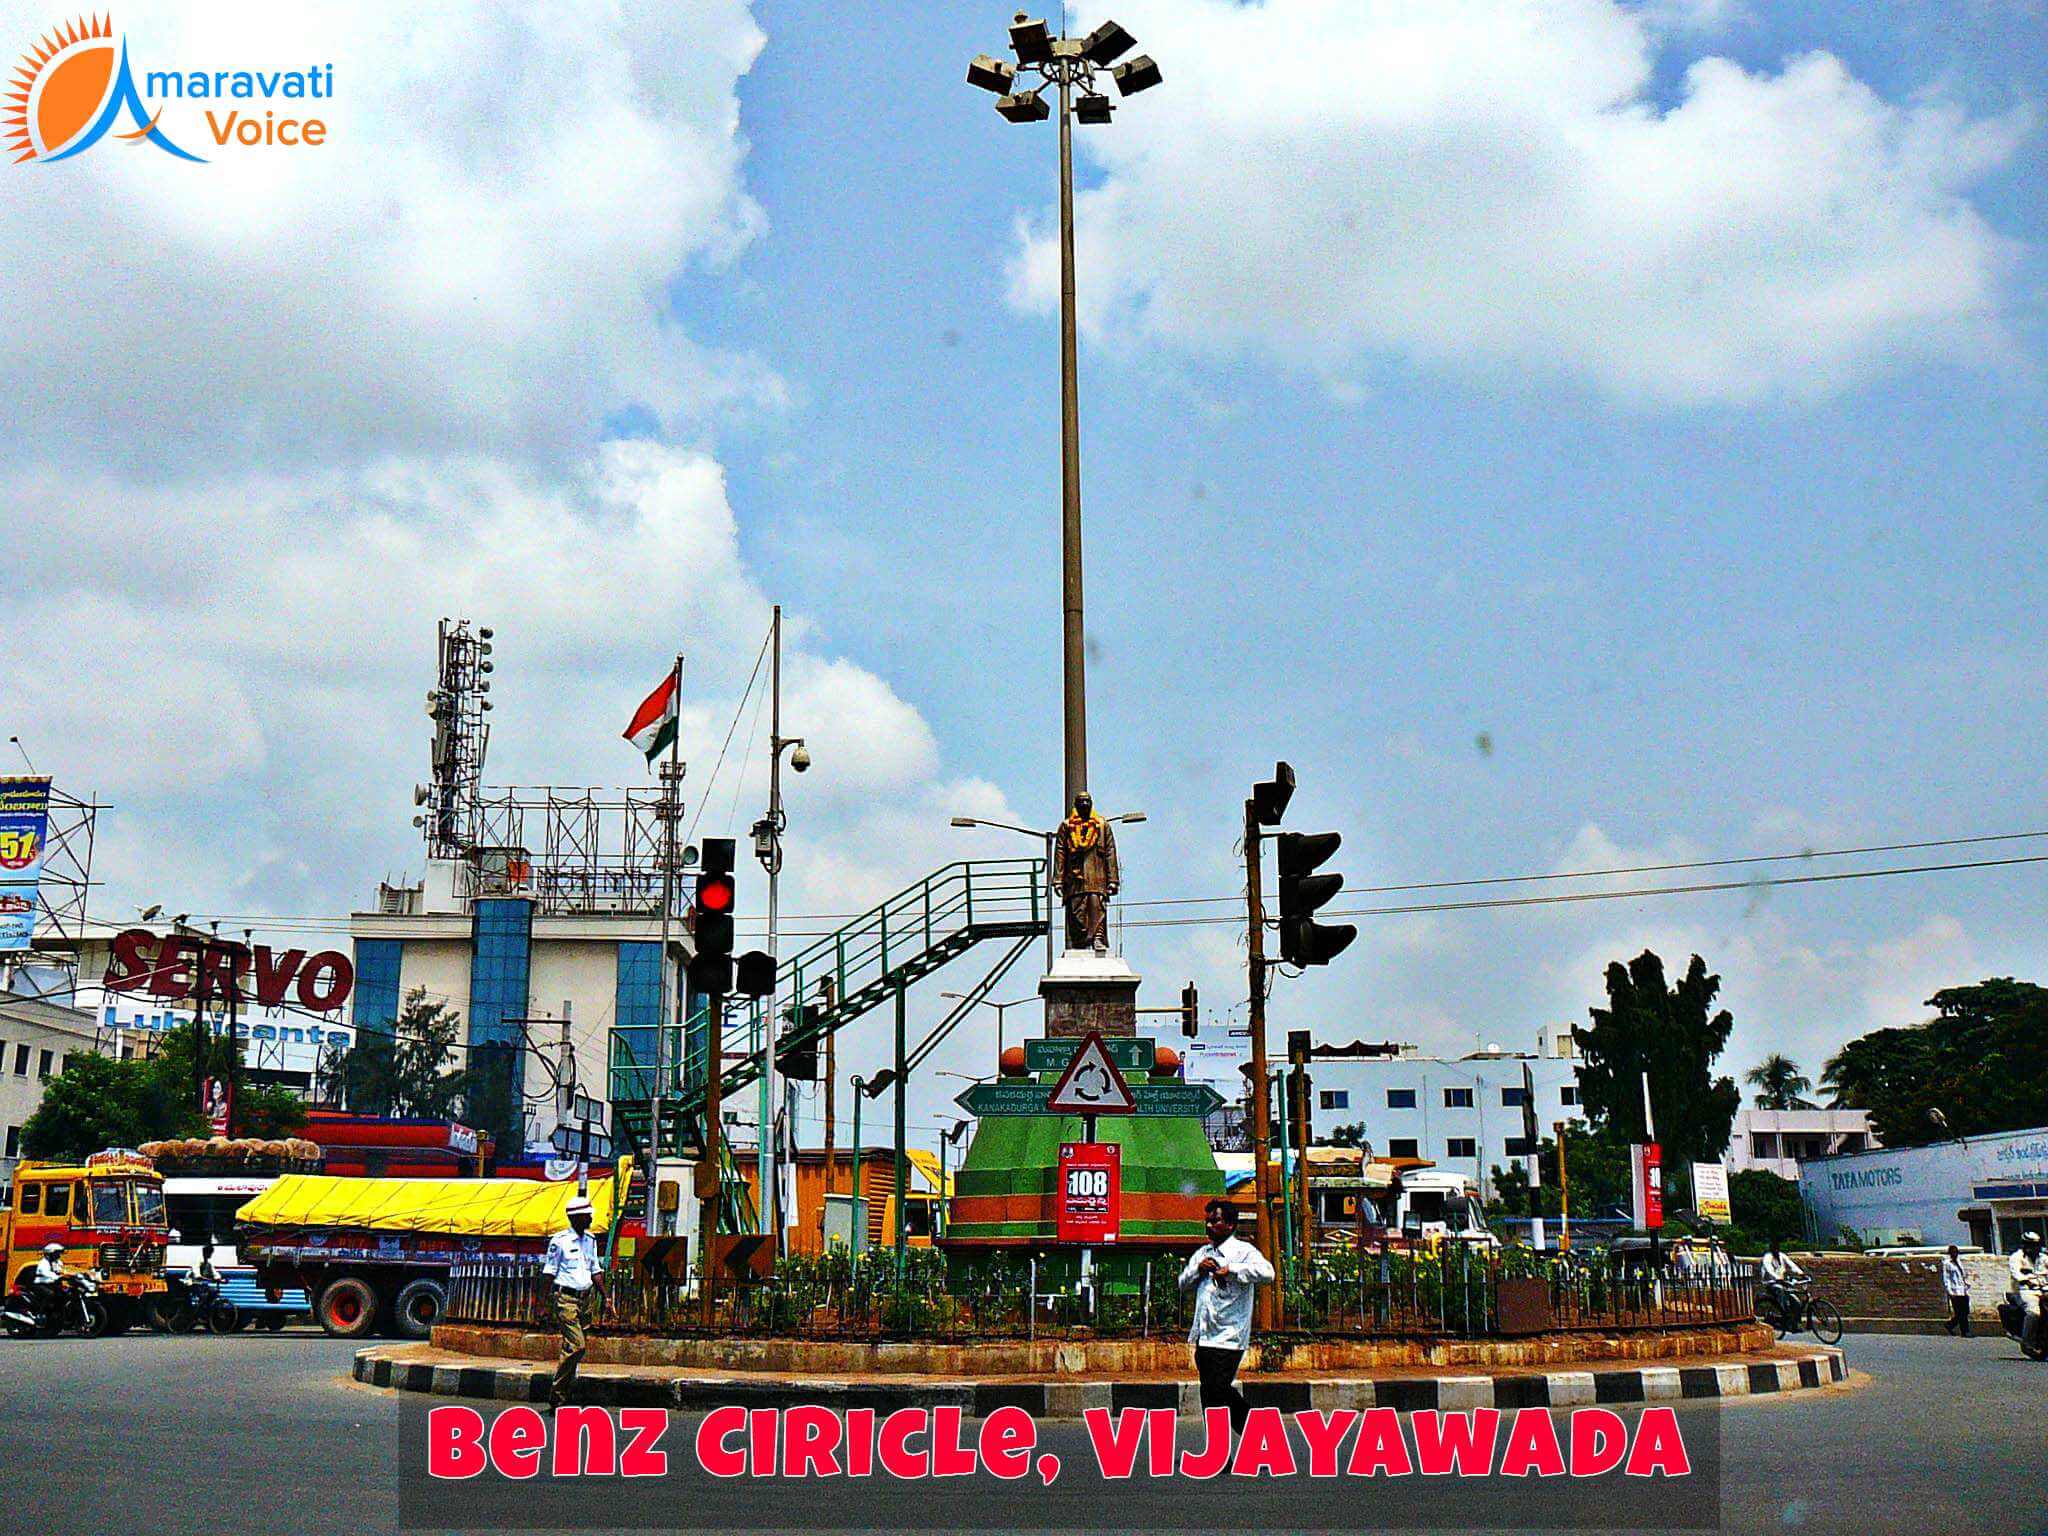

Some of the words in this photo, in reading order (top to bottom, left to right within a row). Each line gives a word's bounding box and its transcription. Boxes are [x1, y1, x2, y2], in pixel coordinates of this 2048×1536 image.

[103, 928, 354, 1011] SERVO
[977, 1103, 1041, 1113] KANAKADURGA
[1155, 1103, 1200, 1113] UNIVERSITY
[1068, 1170, 1108, 1196] 108
